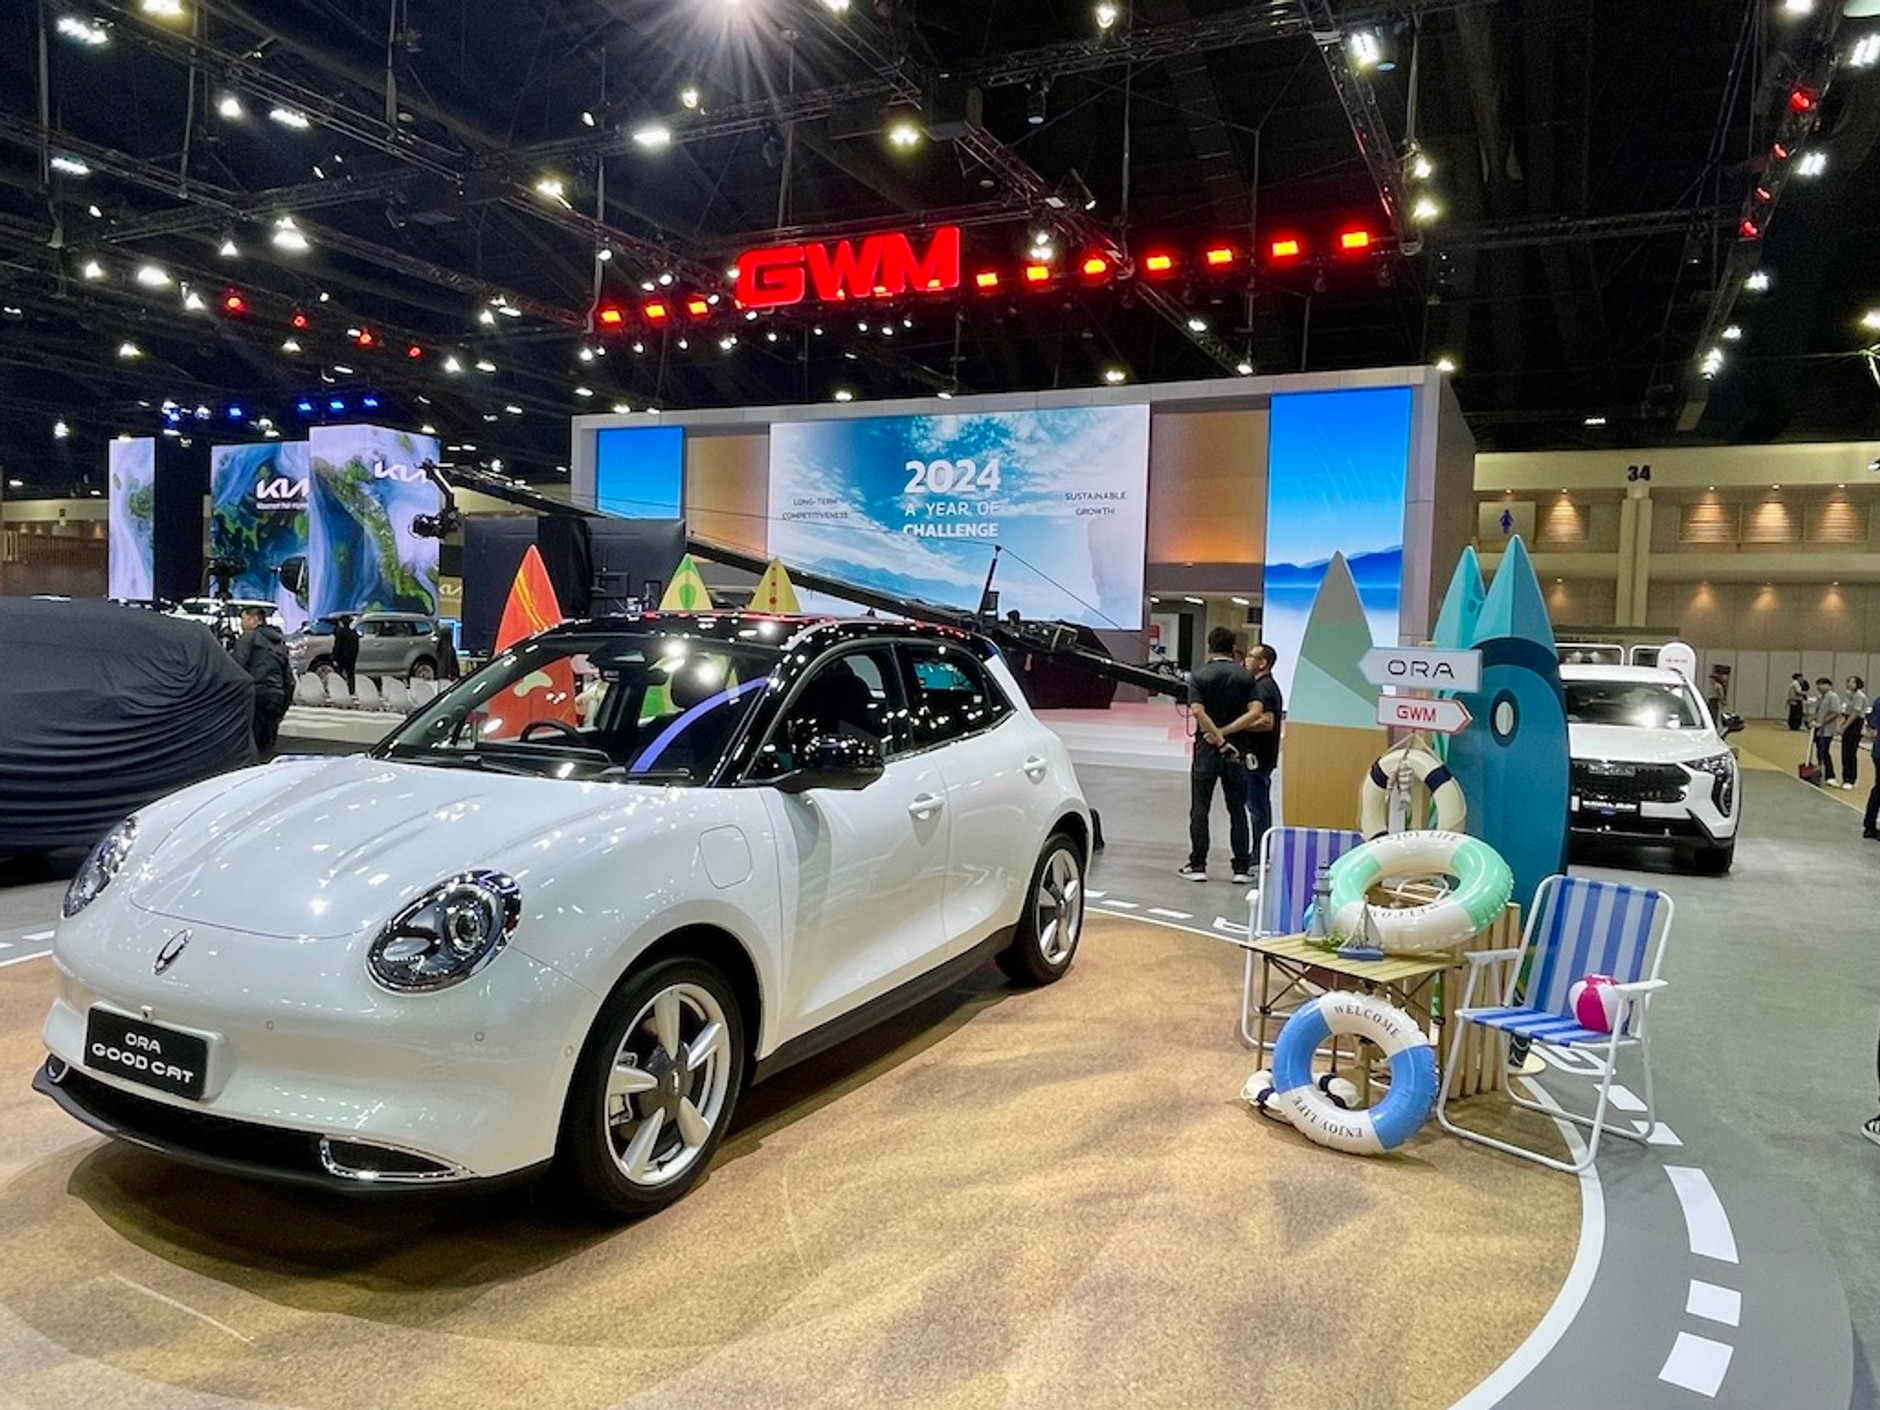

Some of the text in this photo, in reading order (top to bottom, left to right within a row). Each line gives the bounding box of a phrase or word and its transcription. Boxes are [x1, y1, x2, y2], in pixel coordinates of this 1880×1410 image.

[735, 226, 960, 308] GWM
[904, 458, 1002, 494] 2024
[1628, 464, 1650, 481] 34
[1065, 491, 1127, 501] SUSTAINABLE
[782, 511, 848, 521] COMPETITIVENESS
[905, 500, 1000, 517] A YEAR OF
[1075, 507, 1116, 516] GROWTH
[903, 522, 999, 538] CHALLENGE
[1388, 659, 1455, 679] ORA
[1397, 704, 1437, 723] GWM
[1334, 1004, 1401, 1038] WELCOME
[124, 1032, 162, 1055] ORA
[91, 1042, 194, 1084] GOOD CAT
[1291, 1096, 1365, 1138] ENJOY LIFE
